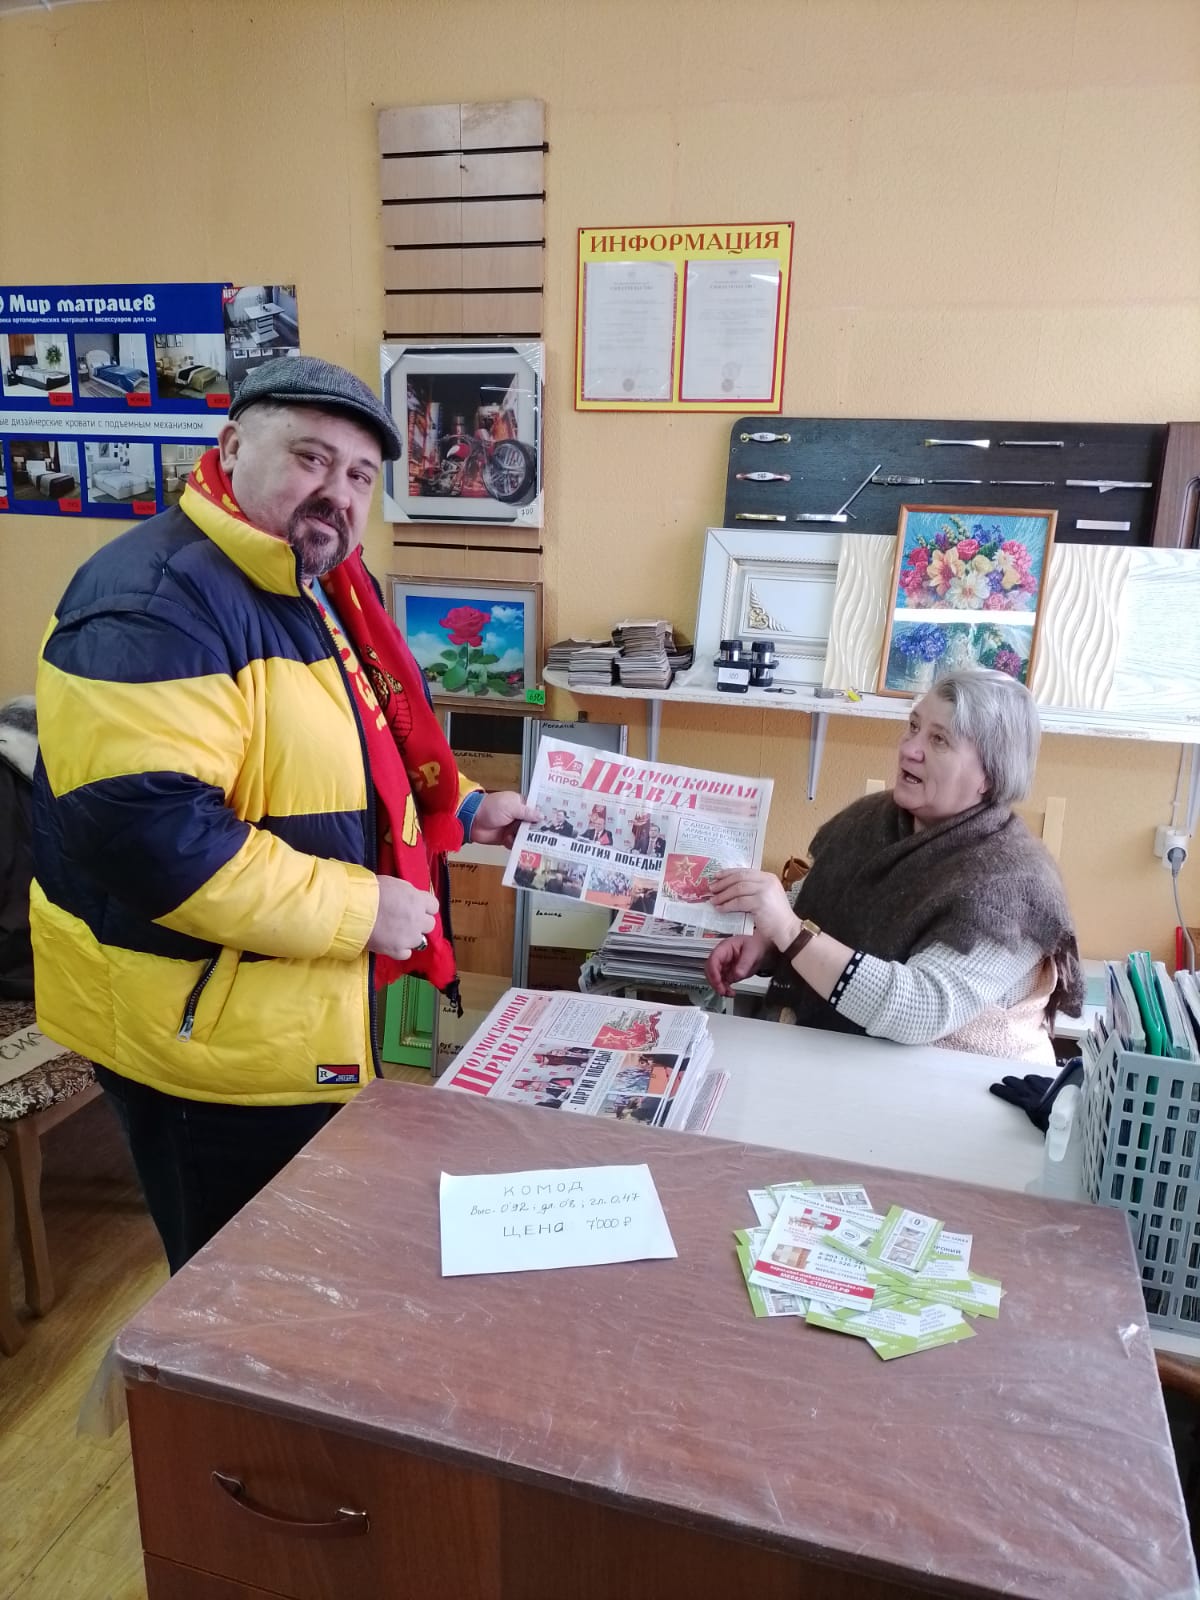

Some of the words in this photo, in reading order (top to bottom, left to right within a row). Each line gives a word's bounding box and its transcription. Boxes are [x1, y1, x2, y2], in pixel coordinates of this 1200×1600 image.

[591, 230, 780, 254] ИНФОРМАЦИЯ
[9, 294, 50, 314] Мир
[57, 294, 155, 314] матрацев
[11, 418, 63, 428] дизайнерские
[65, 420, 96, 428] кровати
[105, 420, 151, 429] подъемным
[153, 422, 203, 430] механизмом
[547, 773, 580, 788] КПРФ
[526, 832, 558, 847] КПРФ
[570, 842, 611, 860] ПАРТИЯ
[614, 852, 663, 871] ПОБЕДЫ!
[319, 1070, 328, 1078] R
[570, 1072, 594, 1105] ПАРТИЯ
[503, 1181, 584, 1197] КОМОД
